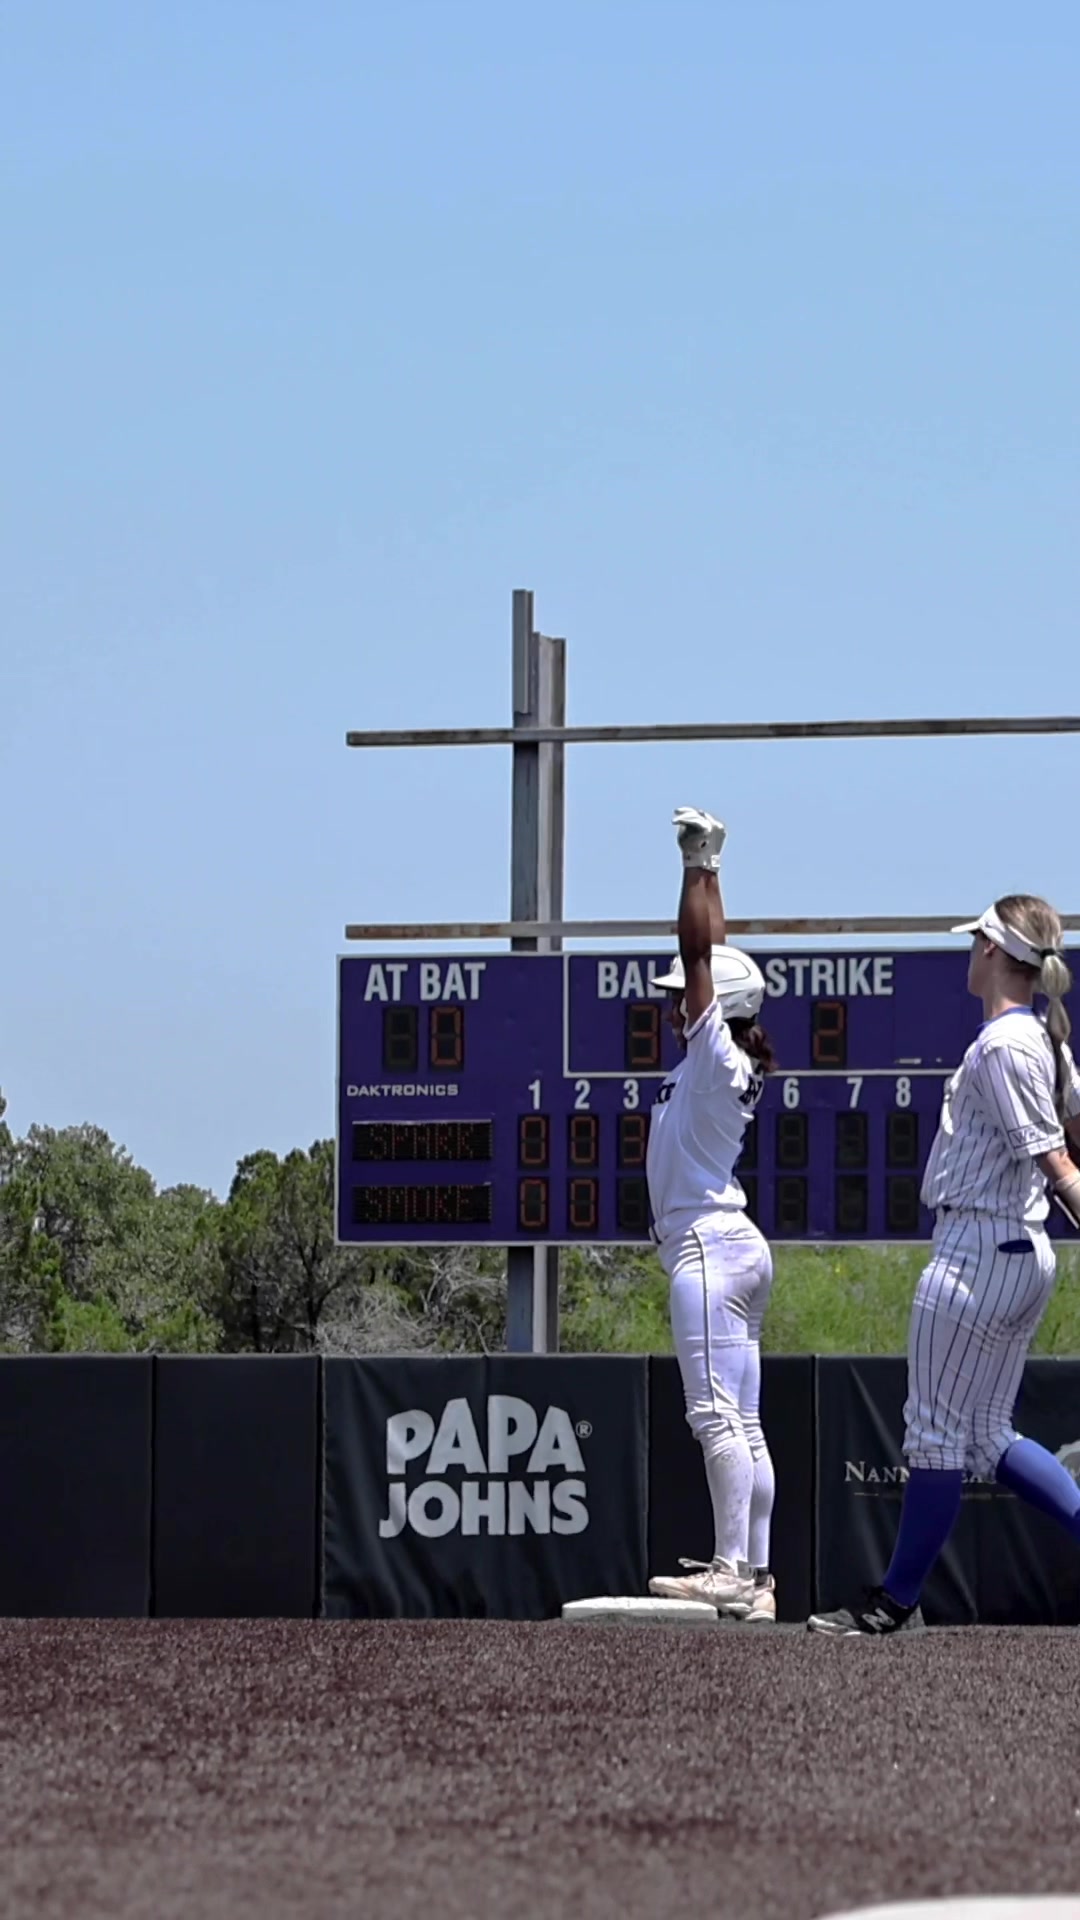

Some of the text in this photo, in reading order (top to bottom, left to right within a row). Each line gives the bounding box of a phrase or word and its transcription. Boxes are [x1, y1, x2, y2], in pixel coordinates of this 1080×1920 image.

[364, 962, 486, 1001] AT BAT
[598, 959, 673, 999] BAL
[765, 957, 894, 998] STRIKE
[813, 1002, 844, 1062] 2
[346, 1084, 459, 1097] DAKTRONICS
[528, 1079, 541, 1110] 1
[574, 1079, 591, 1110] 2
[623, 1079, 639, 1109] 3
[783, 1077, 800, 1109] 6
[847, 1077, 863, 1108] 7
[896, 1077, 911, 1108] 8
[378, 1478, 590, 1539] JOHNS
